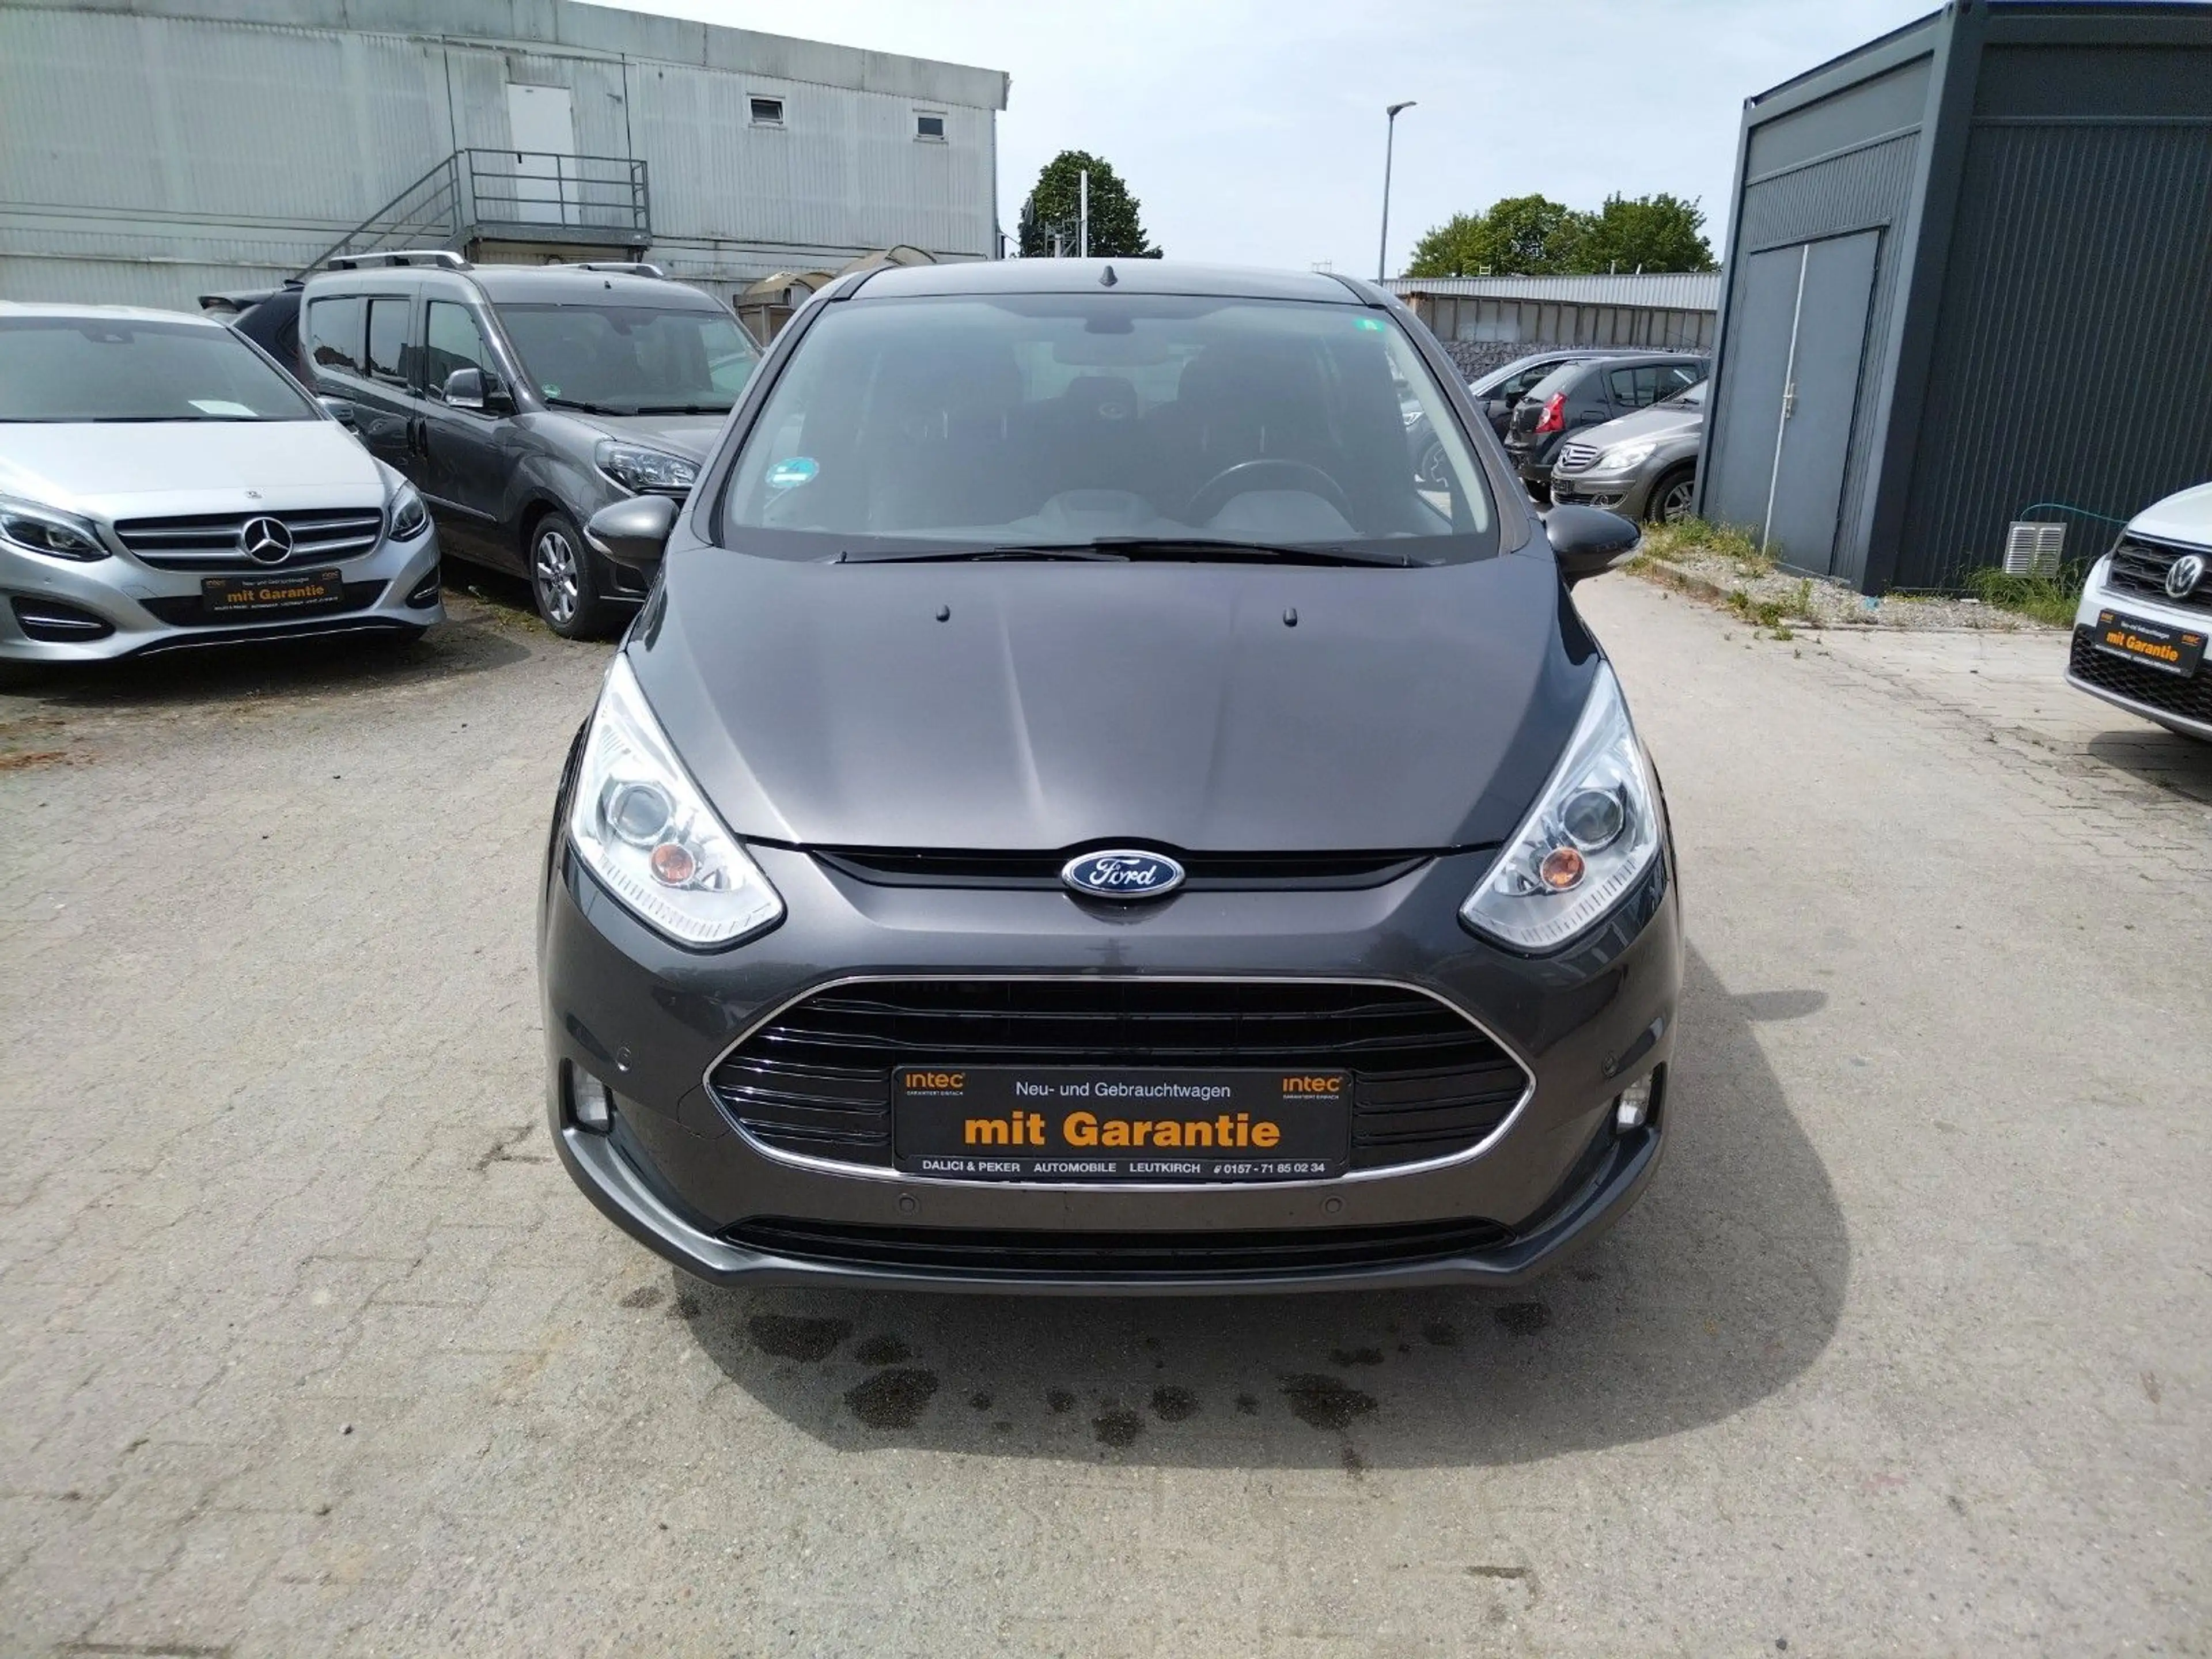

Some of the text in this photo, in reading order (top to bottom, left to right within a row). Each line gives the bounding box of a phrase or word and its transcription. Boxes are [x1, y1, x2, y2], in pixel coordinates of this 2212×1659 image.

[227, 585, 325, 603] mit Garantie
[2106, 631, 2125, 646] mit
[2126, 635, 2179, 662] Garantie
[1089, 858, 1157, 885] Ford
[1016, 1081, 1231, 1101] Neu- und Gebrauchtwagen
[964, 1111, 1281, 1147] mit Garantie
[922, 1160, 964, 1171] DALICI
[966, 1161, 976, 1172] &
[979, 1162, 1020, 1172] PEKER
[1033, 1162, 1117, 1173] AUTOMOBILE
[1129, 1162, 1201, 1174] LEUTKIRCH
[1224, 1164, 1252, 1174] 0157
[1260, 1164, 1273, 1173] 71
[1277, 1163, 1291, 1173] 85
[1294, 1162, 1308, 1173] 02
[1310, 1162, 1325, 1173] 34
